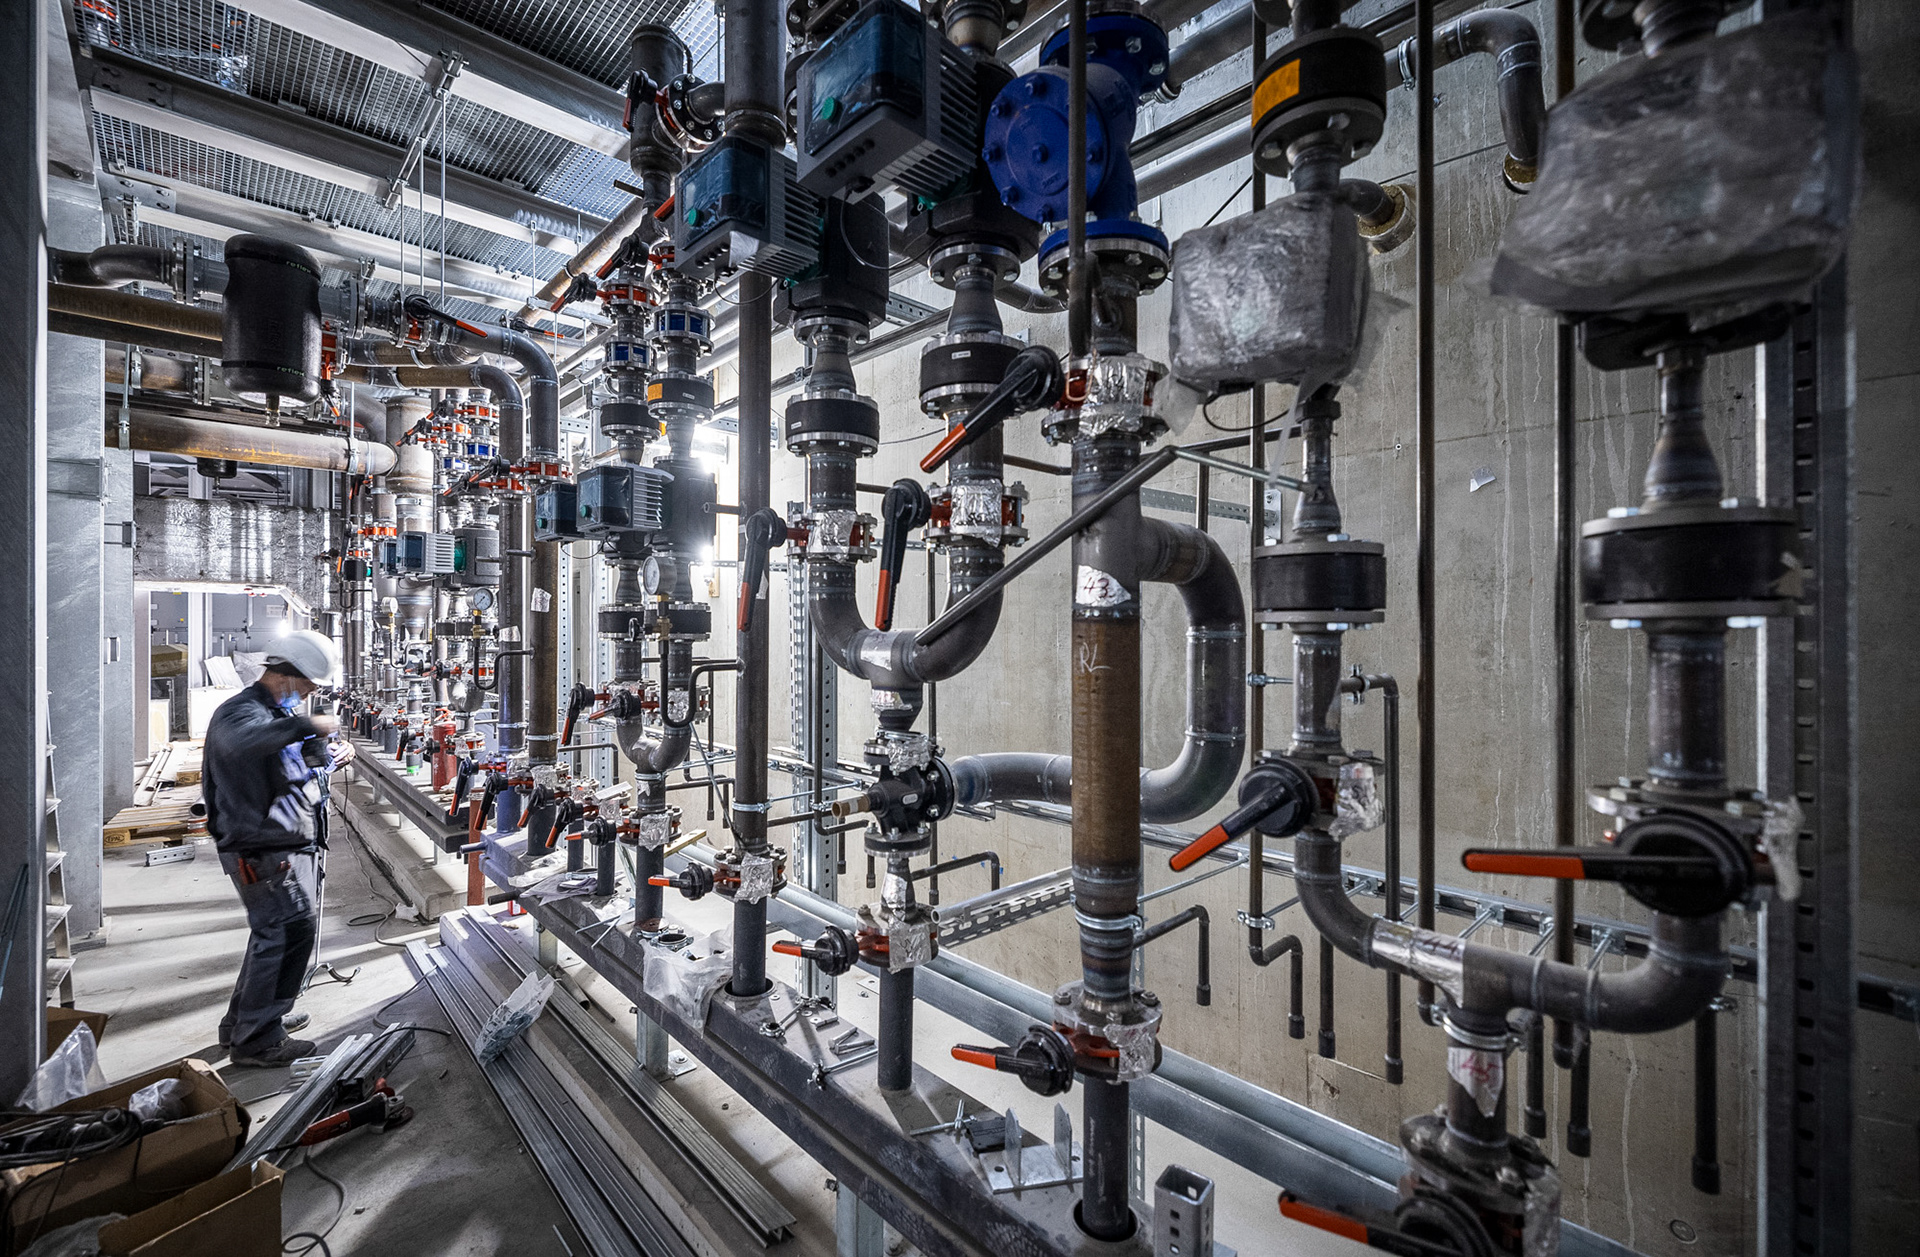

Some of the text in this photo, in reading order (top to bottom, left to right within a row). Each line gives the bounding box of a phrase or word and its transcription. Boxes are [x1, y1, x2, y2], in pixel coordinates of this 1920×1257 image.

[276, 366, 305, 377] reflex
[1083, 577, 1110, 599] 43
[1079, 641, 1111, 673] RL
